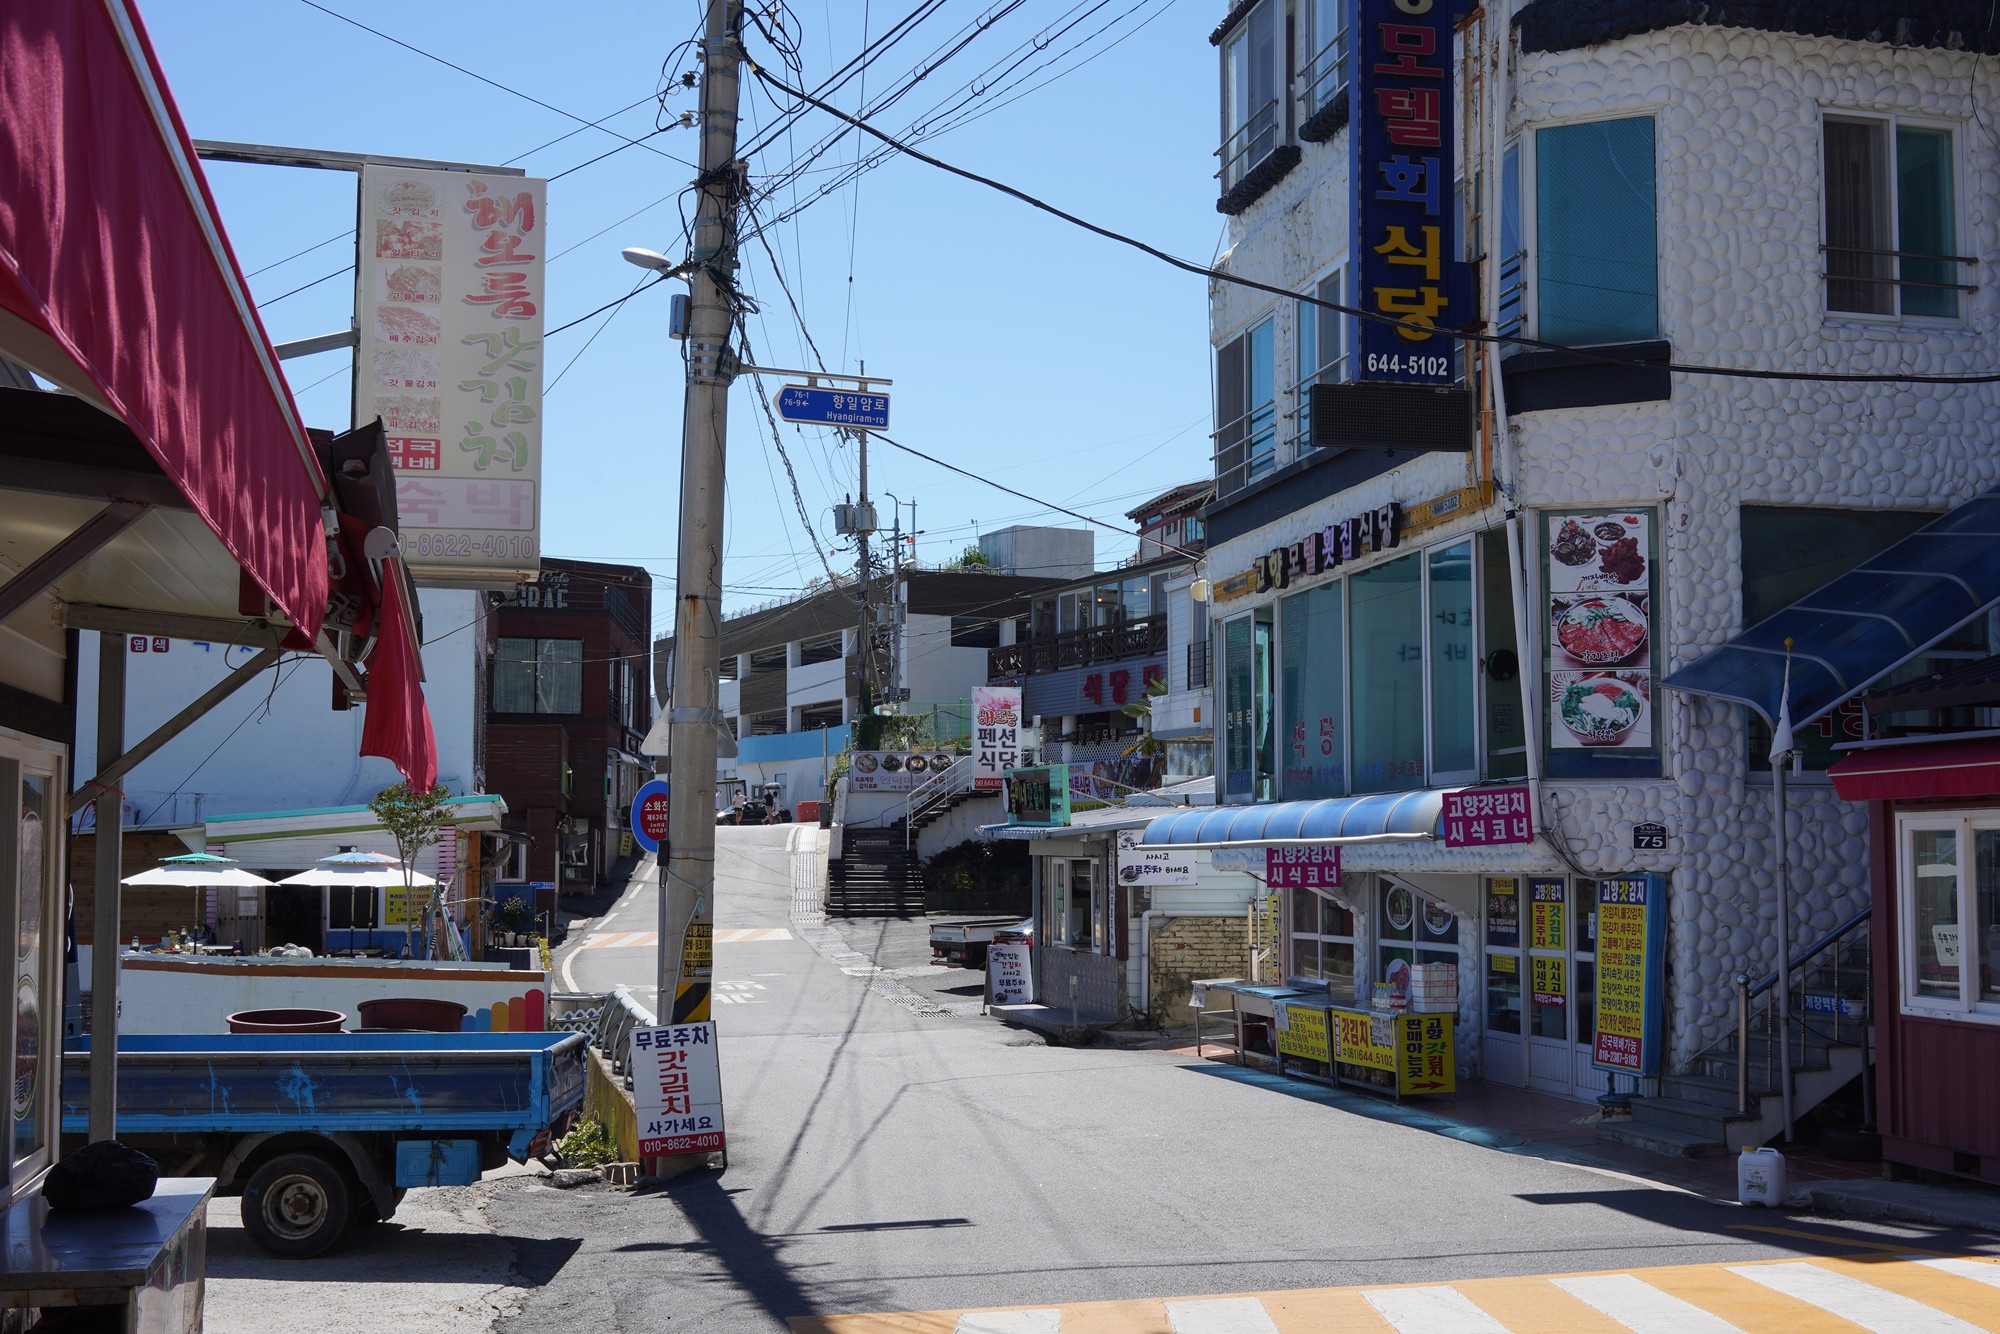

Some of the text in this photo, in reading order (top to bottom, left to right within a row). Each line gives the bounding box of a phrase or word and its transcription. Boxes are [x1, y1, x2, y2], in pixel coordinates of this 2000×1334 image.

[460, 180, 541, 471] 해오름 갓김치
[389, 334, 437, 345] 배추김치
[1367, 353, 1448, 376] 644-5102
[784, 398, 801, 407] 76-9
[794, 390, 810, 398] 76-1
[833, 394, 886, 411] 향일암로
[826, 411, 885, 424] Hyangiram-ro
[133, 638, 168, 652] 염색
[1581, 650, 1620, 664] 갈치조림
[977, 709, 1018, 726] 해뜨는
[977, 728, 1017, 749] 펜션
[977, 751, 1018, 772] 식당
[644, 801, 668, 812] 소화전
[1448, 792, 1525, 818] 고향갓김치
[1638, 836, 1663, 847] 75
[1145, 852, 1169, 860] 사시고
[1271, 846, 1337, 865] 고향갓김치
[1126, 864, 1189, 875] 무료주차 하세요
[1535, 884, 1562, 901] 고향갓김치
[1602, 879, 1645, 902] 고향갓김치
[1535, 904, 1546, 947] 무료주차
[1549, 905, 1561, 947] 갓김치
[998, 978, 1026, 987] 무료주차
[1536, 960, 1547, 992] 하세요
[1550, 961, 1561, 993] 사시고
[635, 1025, 710, 1051] 무료주차
[1341, 1017, 1369, 1048] 갓김치
[1405, 1018, 1424, 1078] 판매하는곳
[657, 1050, 691, 1116] 갓김치
[646, 1116, 713, 1135] 사가세요
[644, 1134, 719, 1153] 010-8622-4010
